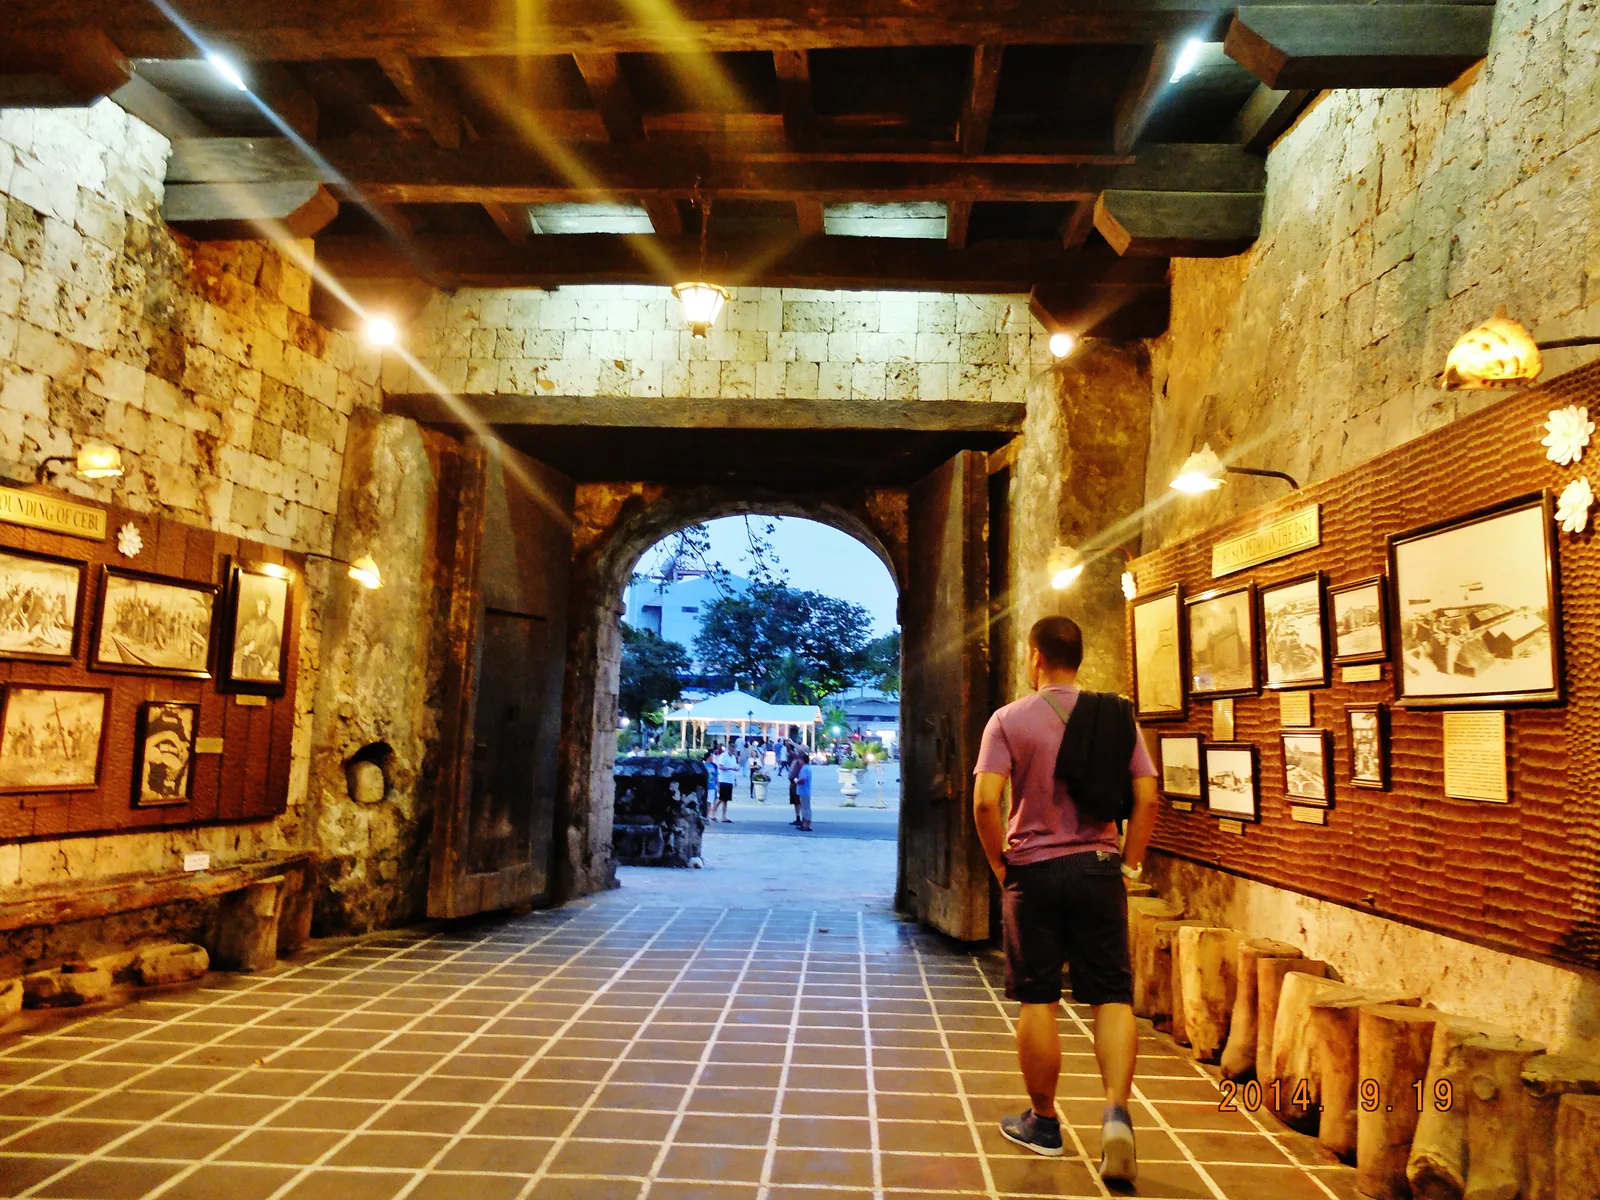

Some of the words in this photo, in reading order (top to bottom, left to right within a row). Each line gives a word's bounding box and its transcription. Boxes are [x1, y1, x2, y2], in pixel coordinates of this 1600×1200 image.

[0, 494, 53, 521] OUNDING
[56, 507, 72, 525] OF
[73, 510, 100, 531] CEBU
[1277, 524, 1293, 547] THE
[1294, 516, 1313, 542] PAST
